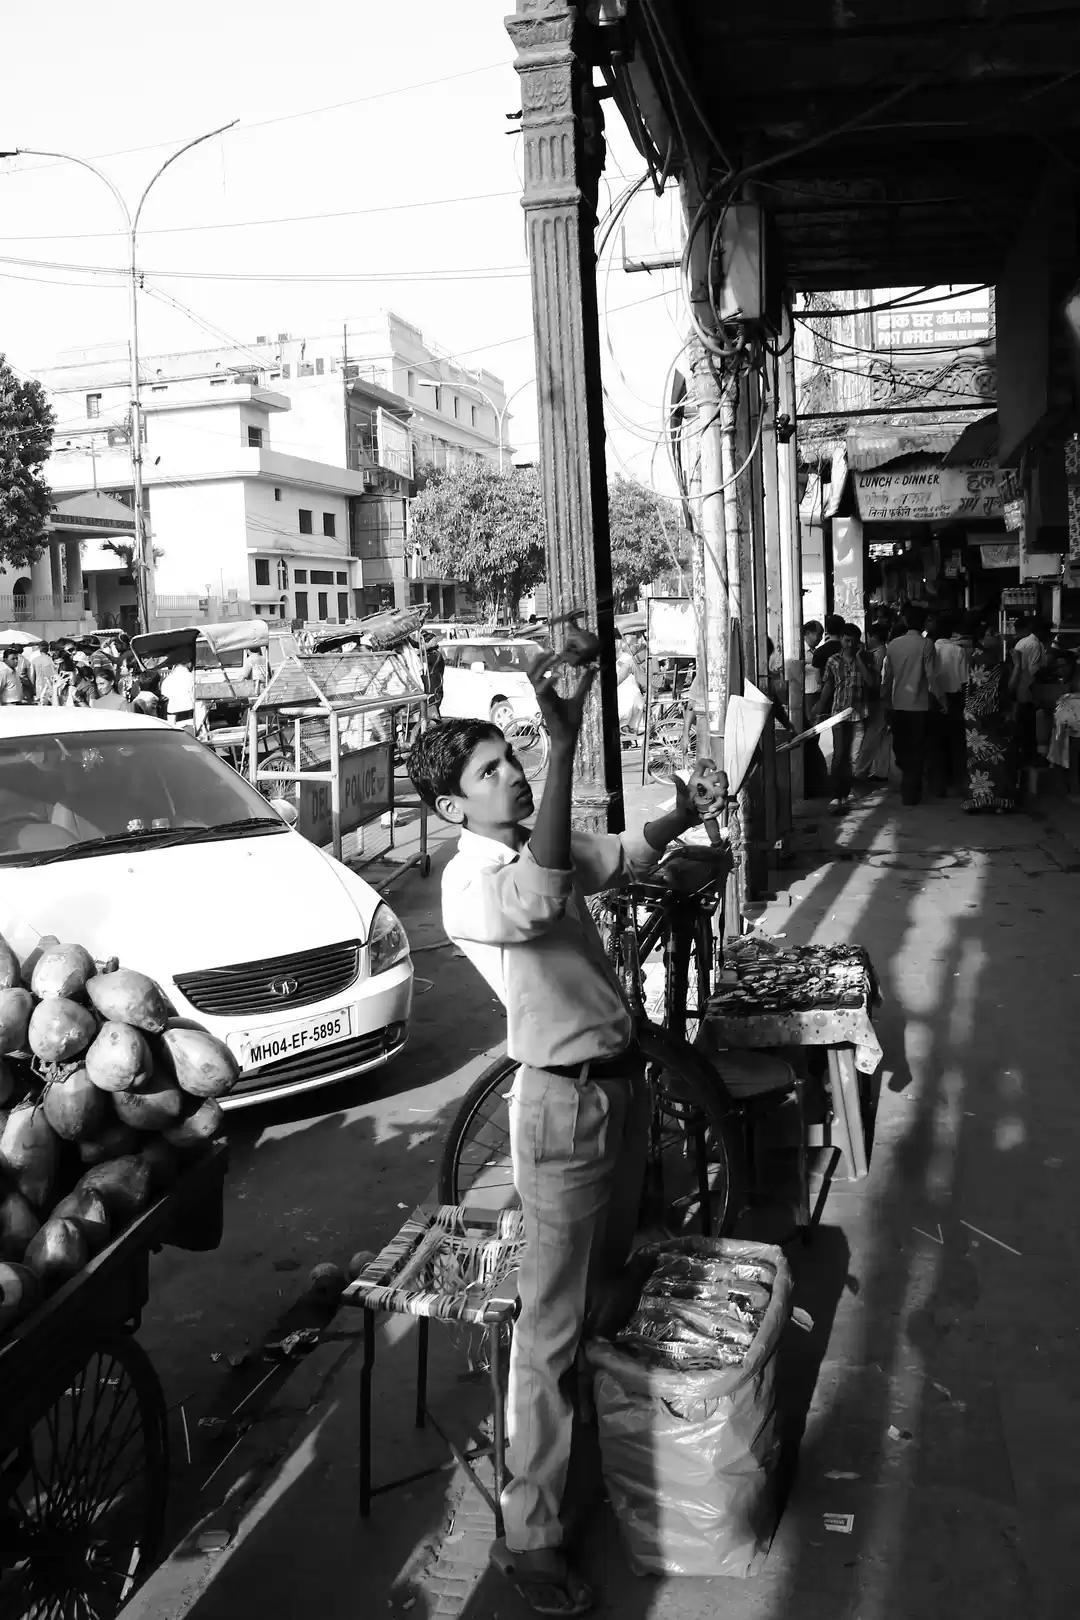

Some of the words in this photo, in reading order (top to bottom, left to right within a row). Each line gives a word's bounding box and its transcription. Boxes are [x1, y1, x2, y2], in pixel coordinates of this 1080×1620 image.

[911, 313, 934, 327] घर
[878, 331, 900, 346] POST
[902, 329, 934, 344] OFFICE
[859, 476, 892, 488] LUNCH
[902, 474, 940, 485] DINNER
[312, 785, 332, 824] DEL
[345, 766, 376, 809] POLICE
[250, 1019, 341, 1064] MH04-EF-5895
